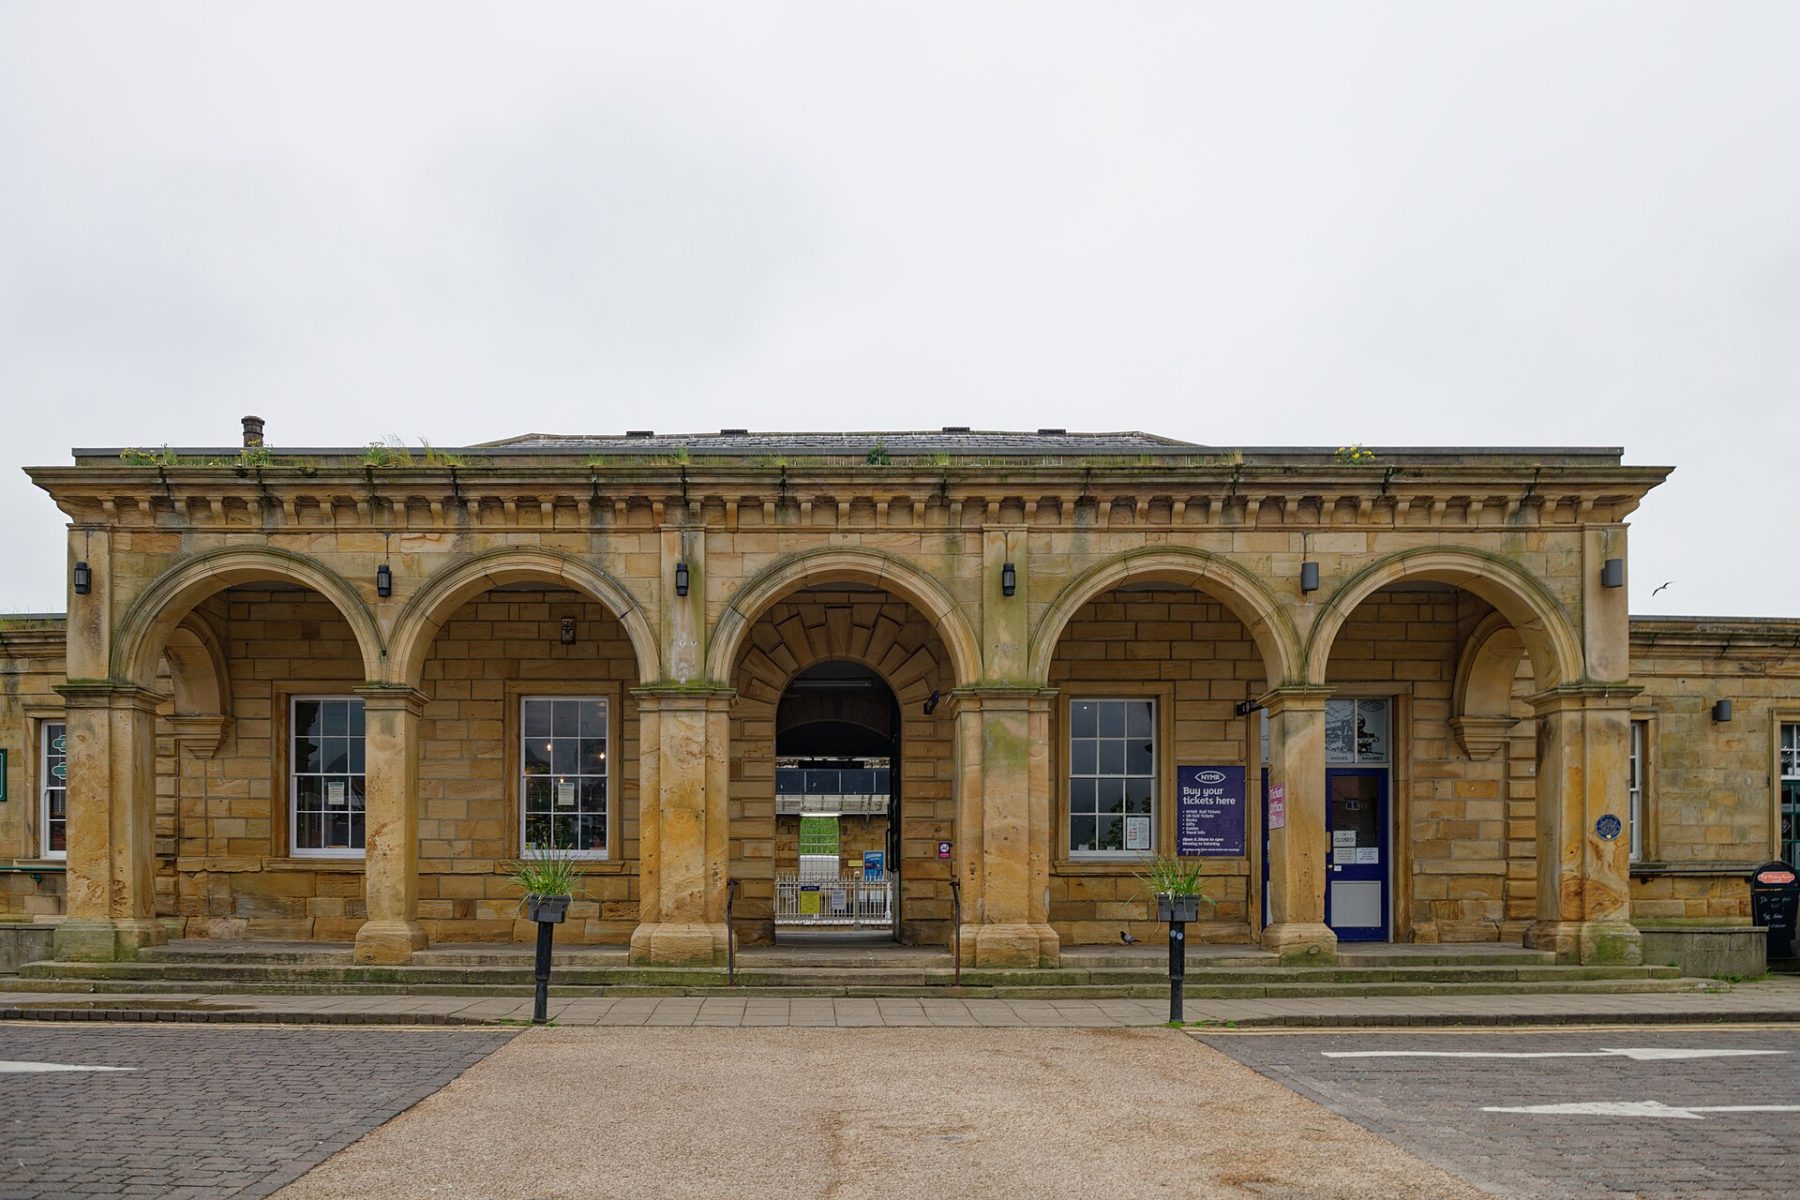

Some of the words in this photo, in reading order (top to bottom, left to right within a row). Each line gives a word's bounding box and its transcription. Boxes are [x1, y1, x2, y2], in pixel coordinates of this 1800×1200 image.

[1183, 787, 1200, 796] Buy
[1203, 788, 1224, 796] your
[1183, 796, 1214, 805] tickets
[1216, 796, 1236, 805] here
